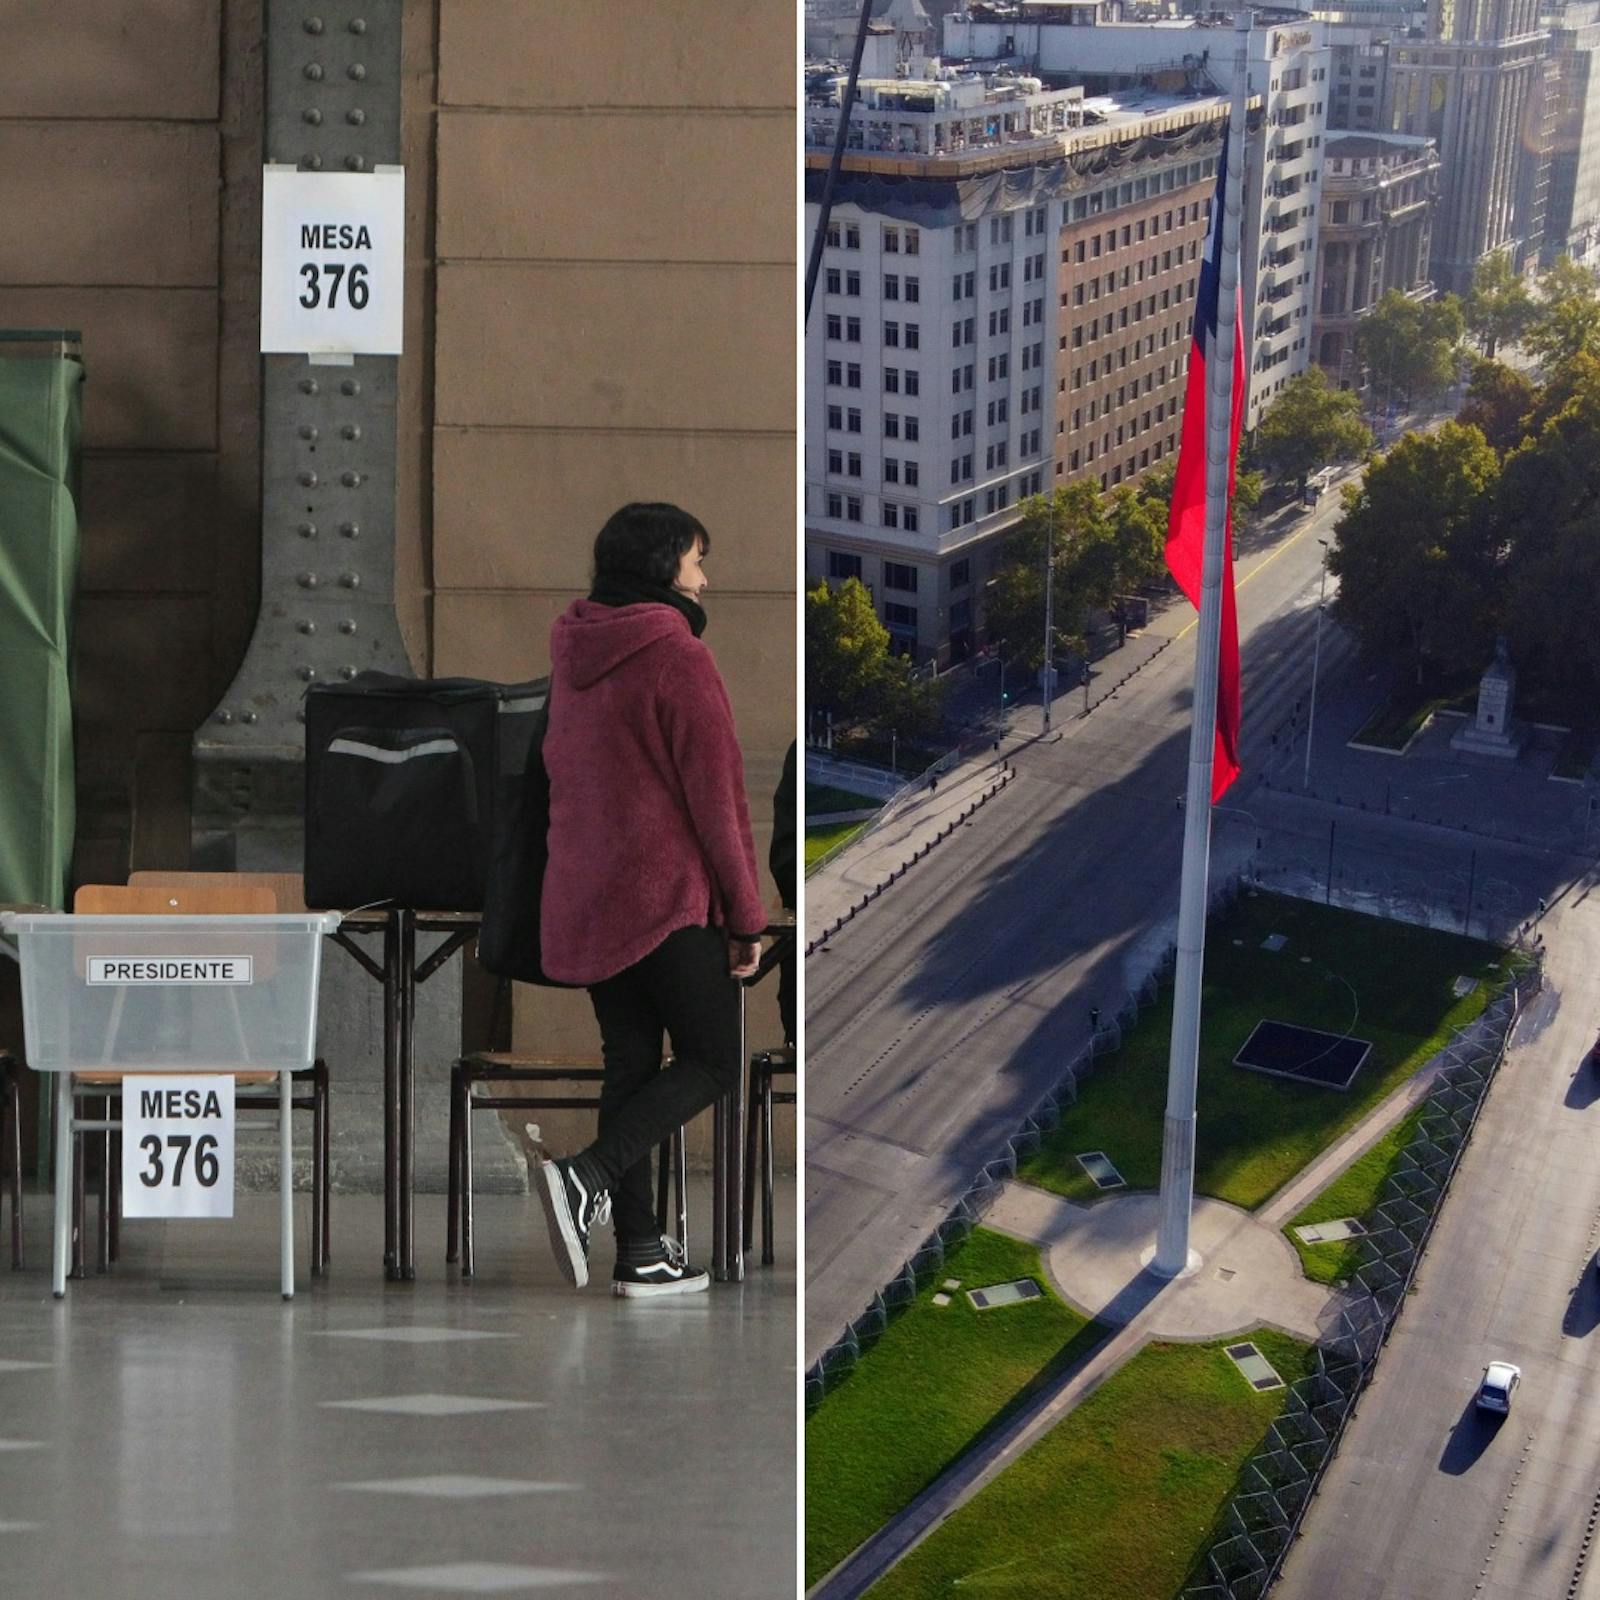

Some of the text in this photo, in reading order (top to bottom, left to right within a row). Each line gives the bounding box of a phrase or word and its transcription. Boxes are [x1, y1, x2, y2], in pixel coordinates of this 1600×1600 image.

[301, 224, 372, 250] MESA
[299, 263, 370, 310] 376
[104, 963, 234, 979] PRESIDENTE
[140, 1090, 222, 1119] MESA
[138, 1134, 219, 1187] 376
